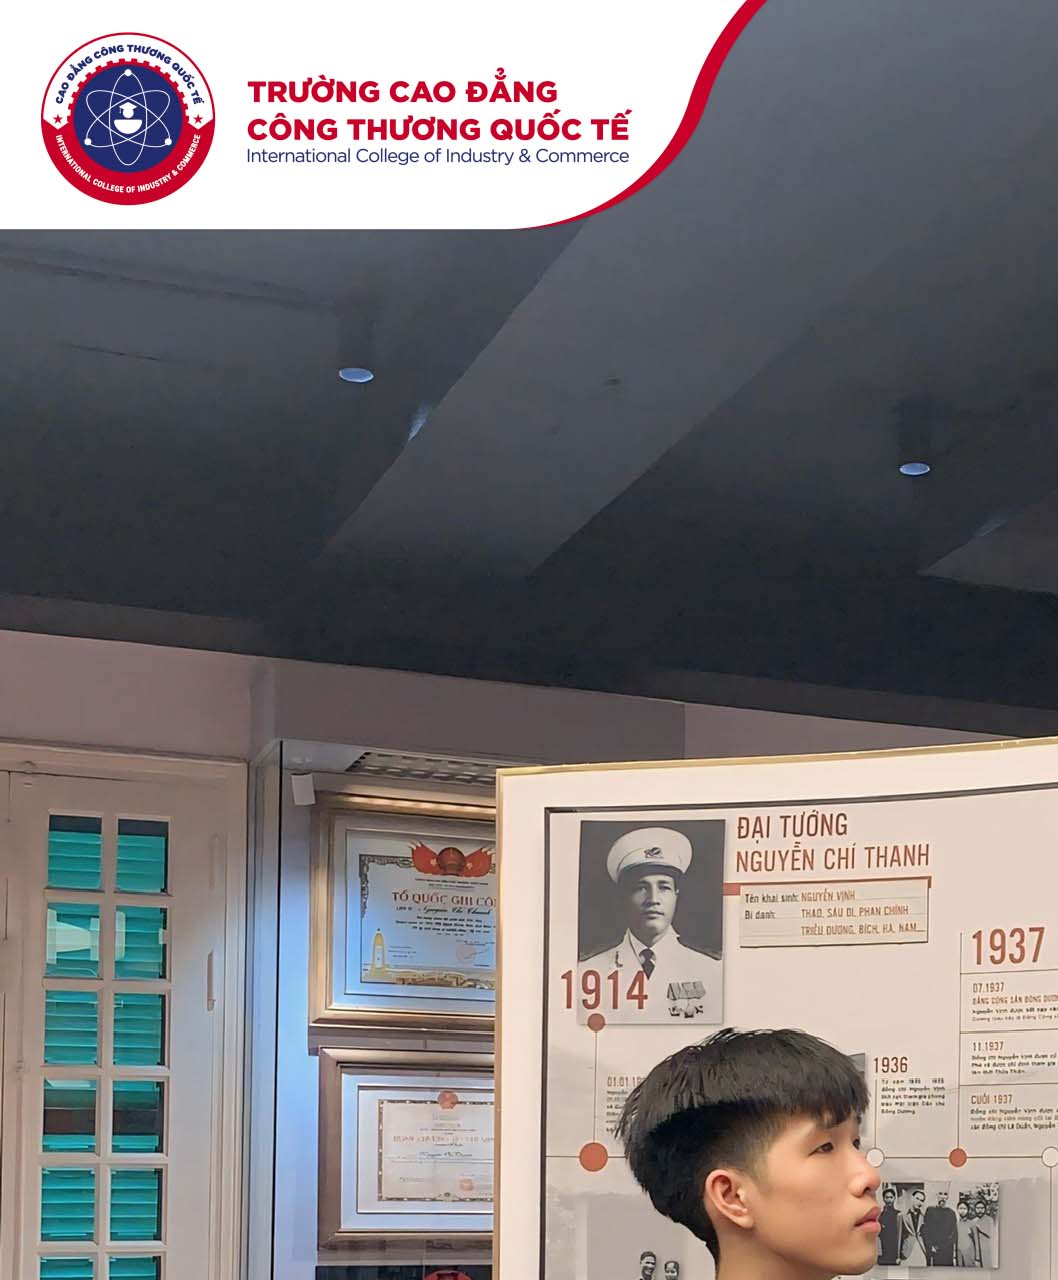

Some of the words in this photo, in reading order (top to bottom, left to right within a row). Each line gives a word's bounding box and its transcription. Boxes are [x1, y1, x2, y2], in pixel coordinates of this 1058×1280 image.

[737, 816, 770, 844] ĐẠI
[780, 809, 848, 838] TƯỚNG
[736, 841, 815, 873] NGUYỄN
[824, 842, 856, 870] CHÍ
[864, 844, 930, 869] THANH
[476, 896, 497, 908] CÔ
[744, 893, 759, 904] Tên
[762, 893, 778, 903] khai
[858, 906, 882, 917] PHAN
[972, 926, 1045, 966] 1937
[560, 968, 649, 1010] 1914
[972, 982, 1005, 993] 07.1937
[972, 1041, 1004, 1052] 11.1937
[874, 1056, 908, 1074] 1936
[970, 1092, 990, 1105] CUỐI
[994, 1094, 1013, 1104] 1937
